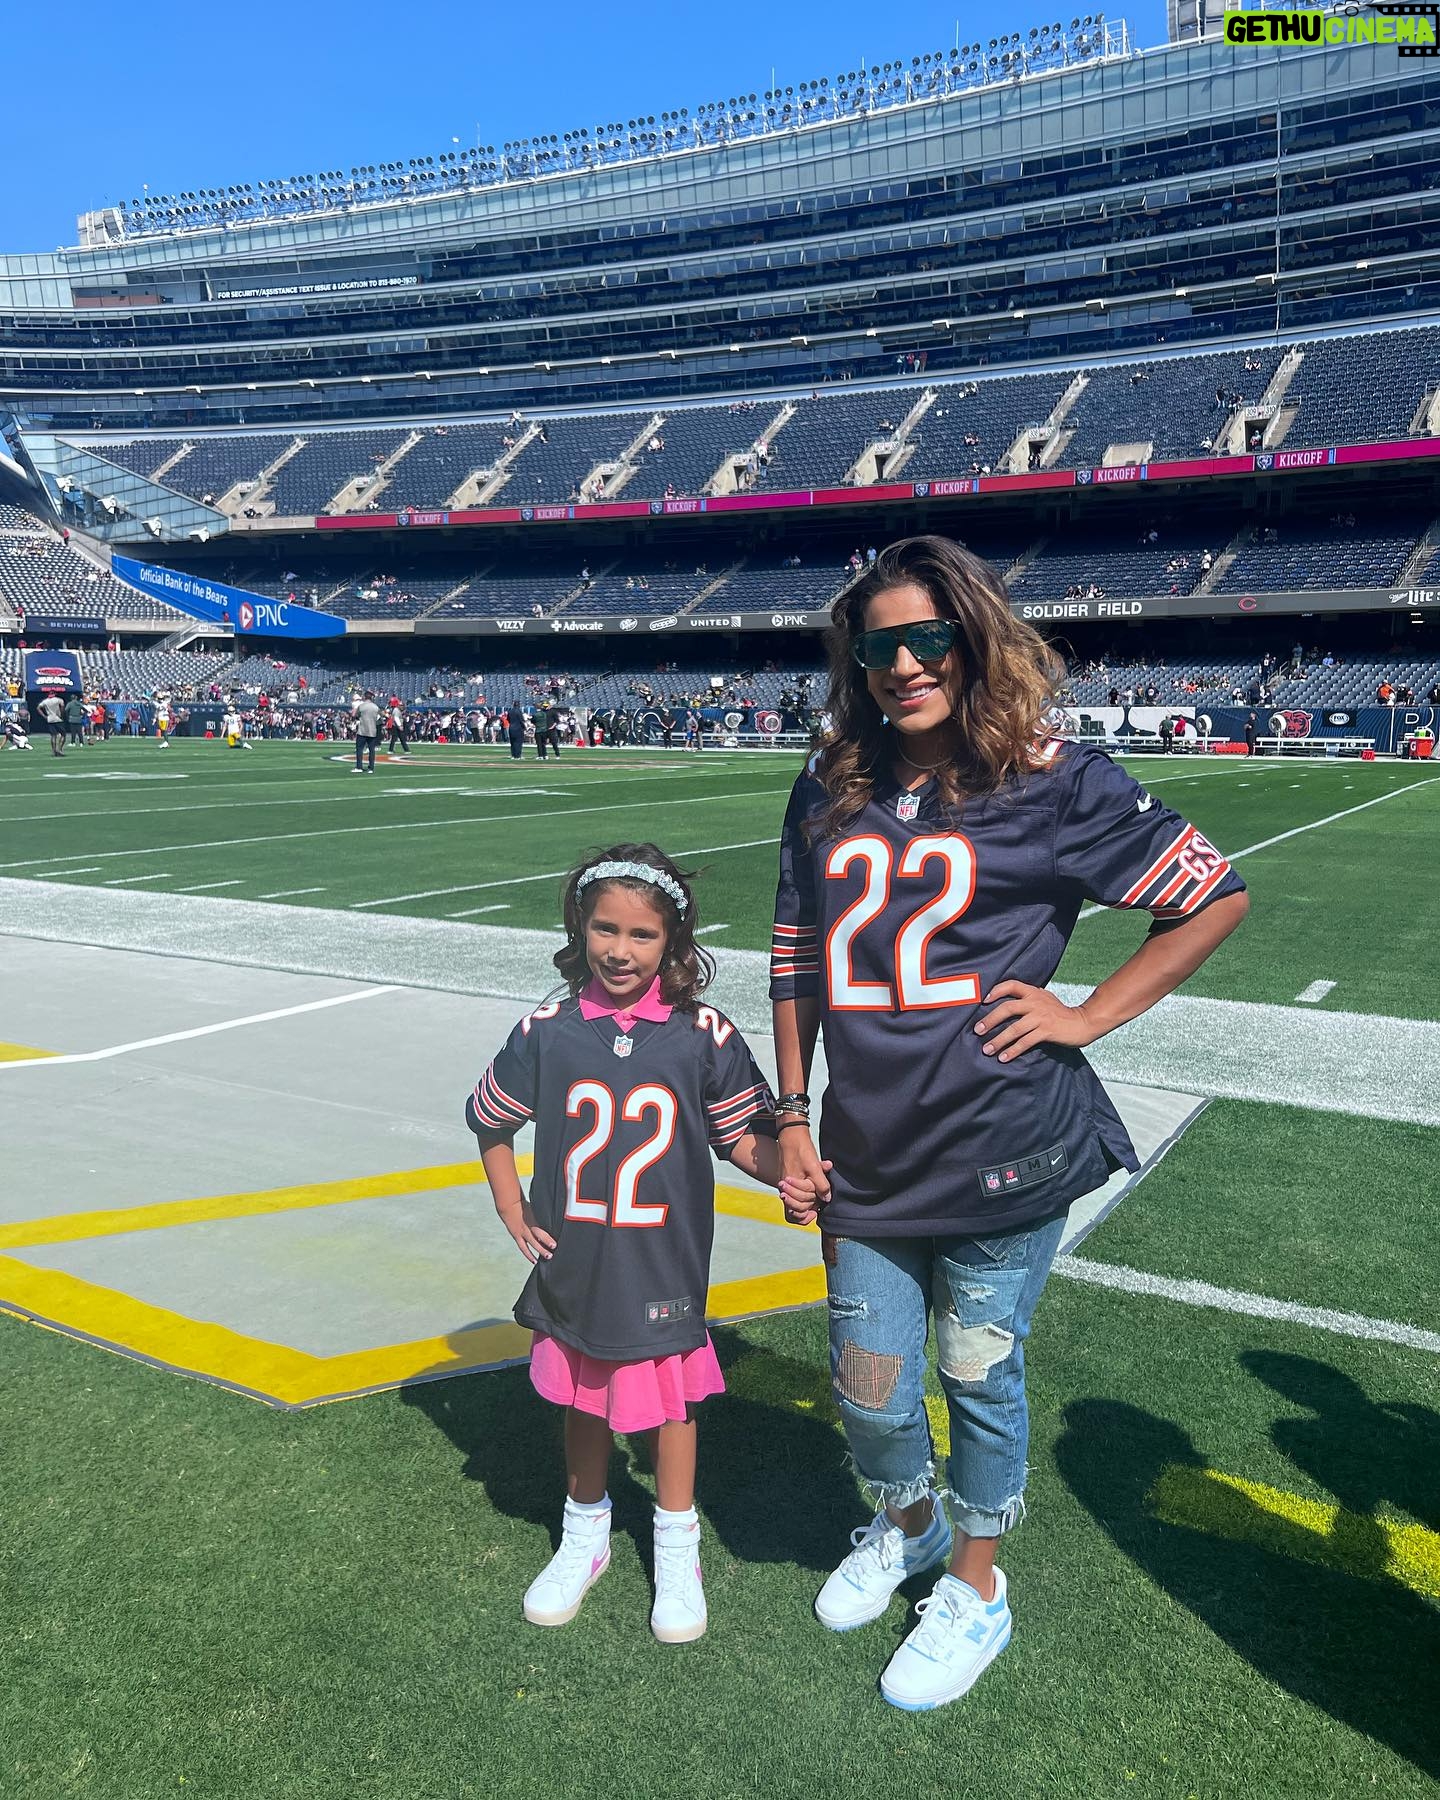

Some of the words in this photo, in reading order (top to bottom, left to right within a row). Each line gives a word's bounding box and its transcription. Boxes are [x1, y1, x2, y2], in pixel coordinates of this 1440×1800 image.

[217, 291, 231, 299] FOR
[299, 285, 314, 293] TEXT
[338, 281, 368, 290] LOCATION
[1279, 451, 1323, 467] KICKOFF
[1097, 468, 1136, 481] KICKOFF
[934, 481, 970, 494] KICKOFF
[666, 501, 698, 512] KICKOFF
[414, 514, 441, 525] KICKOFF
[537, 508, 566, 519] KICKOFF
[140, 568, 164, 585] Official
[165, 574, 182, 590] Bank
[184, 581, 192, 593] of
[192, 583, 205, 597] the
[205, 587, 228, 606] Bears
[1407, 590, 1434, 606] Lite
[255, 603, 289, 627] PNC
[1022, 604, 1089, 619] SOLDIER
[1097, 601, 1143, 616] FIELD
[496, 620, 526, 629] VIZZY
[563, 621, 603, 631] Advocate
[690, 619, 730, 627] UNITED
[784, 615, 808, 626] PNC
[1333, 714, 1345, 722] FOX
[899, 805, 915, 816] NFL
[1178, 831, 1224, 882] GS
[824, 832, 982, 1011] 22
[565, 1079, 678, 1227] 22
[1028, 1159, 1040, 1171] M
